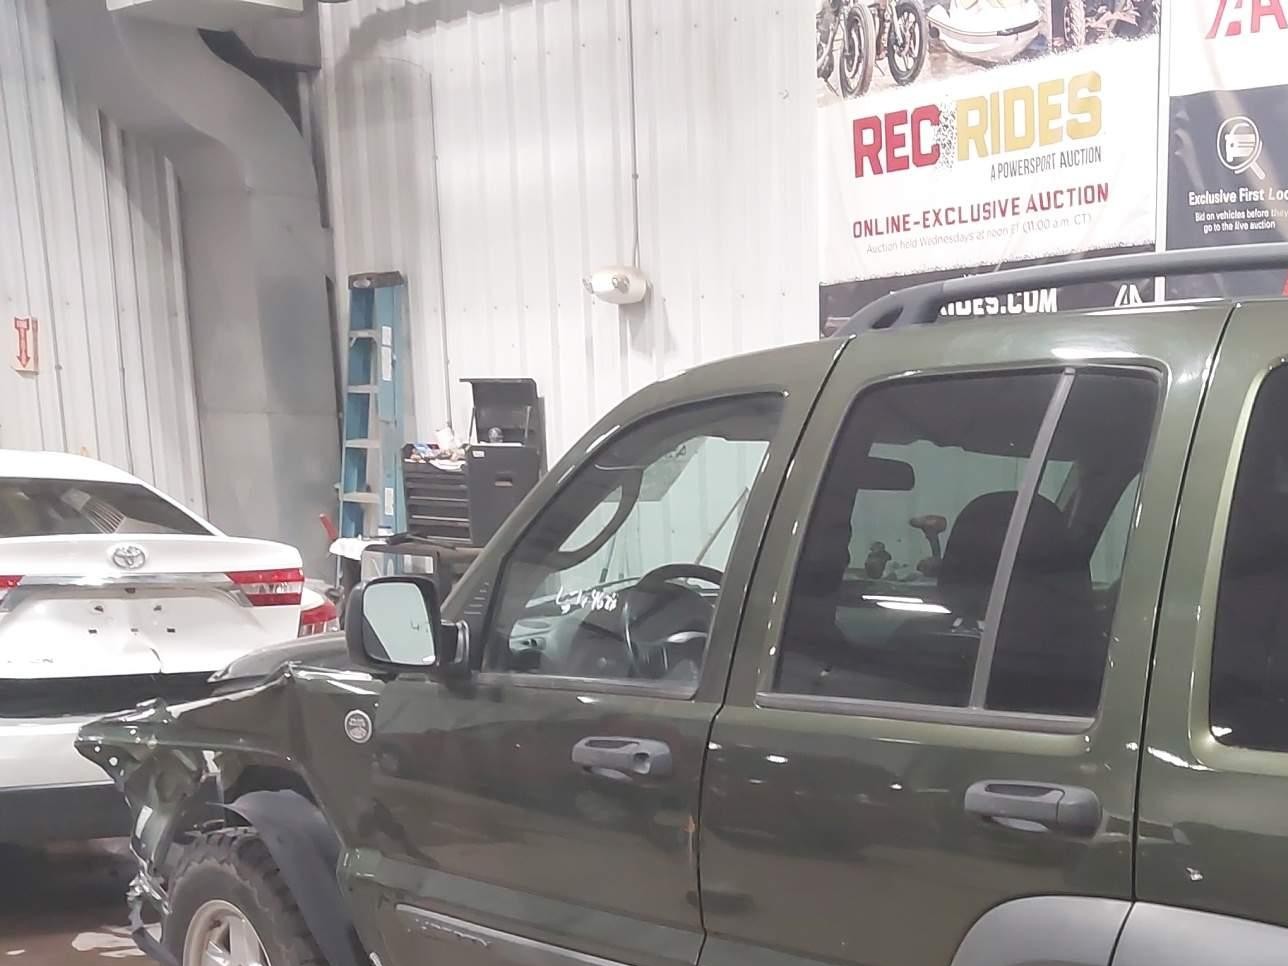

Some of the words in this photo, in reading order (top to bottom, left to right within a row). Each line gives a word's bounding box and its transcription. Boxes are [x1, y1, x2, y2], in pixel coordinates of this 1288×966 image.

[852, 104, 941, 178] REC
[956, 70, 1102, 162] RIDES
[990, 164, 996, 181] A
[998, 152, 1056, 179] POWERSPORT
[1060, 145, 1102, 169] AUCTION
[1188, 189, 1237, 206] Exclusive
[1239, 187, 1264, 202] First
[852, 197, 1021, 239] ONLINE-EXCLUSIVE
[1025, 182, 1109, 214] AUCTION
[1206, 213, 1215, 221] on
[1216, 209, 1246, 220] vehicles
[1246, 208, 1269, 219] before
[1203, 224, 1213, 234] go
[1213, 223, 1221, 232] to
[1222, 222, 1233, 231] the
[1235, 220, 1249, 231] live
[1250, 218, 1276, 231] auction
[867, 241, 898, 255] Auction
[900, 238, 918, 249] held
